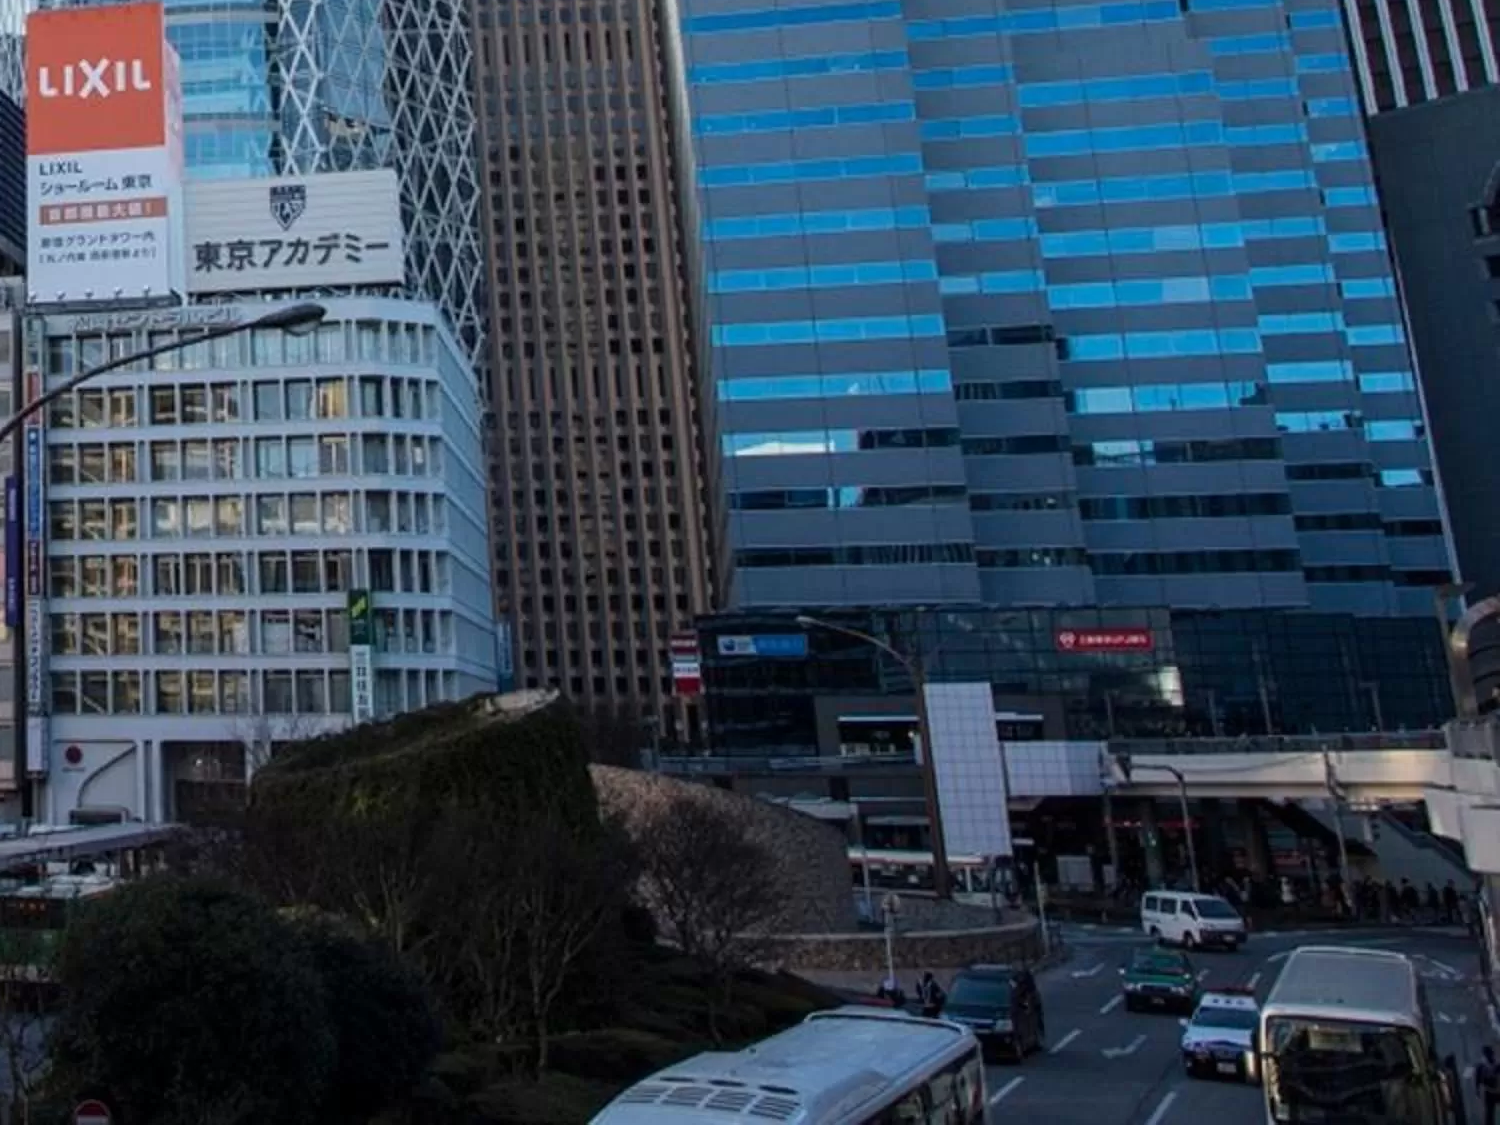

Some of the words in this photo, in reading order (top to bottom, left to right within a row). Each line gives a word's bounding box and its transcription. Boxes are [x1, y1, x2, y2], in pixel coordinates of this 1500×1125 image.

[38, 58, 151, 99] LIXIL
[39, 162, 83, 176] LIXIL
[40, 178, 118, 196] ショールーム
[121, 174, 152, 190] 東京
[193, 233, 390, 273] 東京アカデミー
